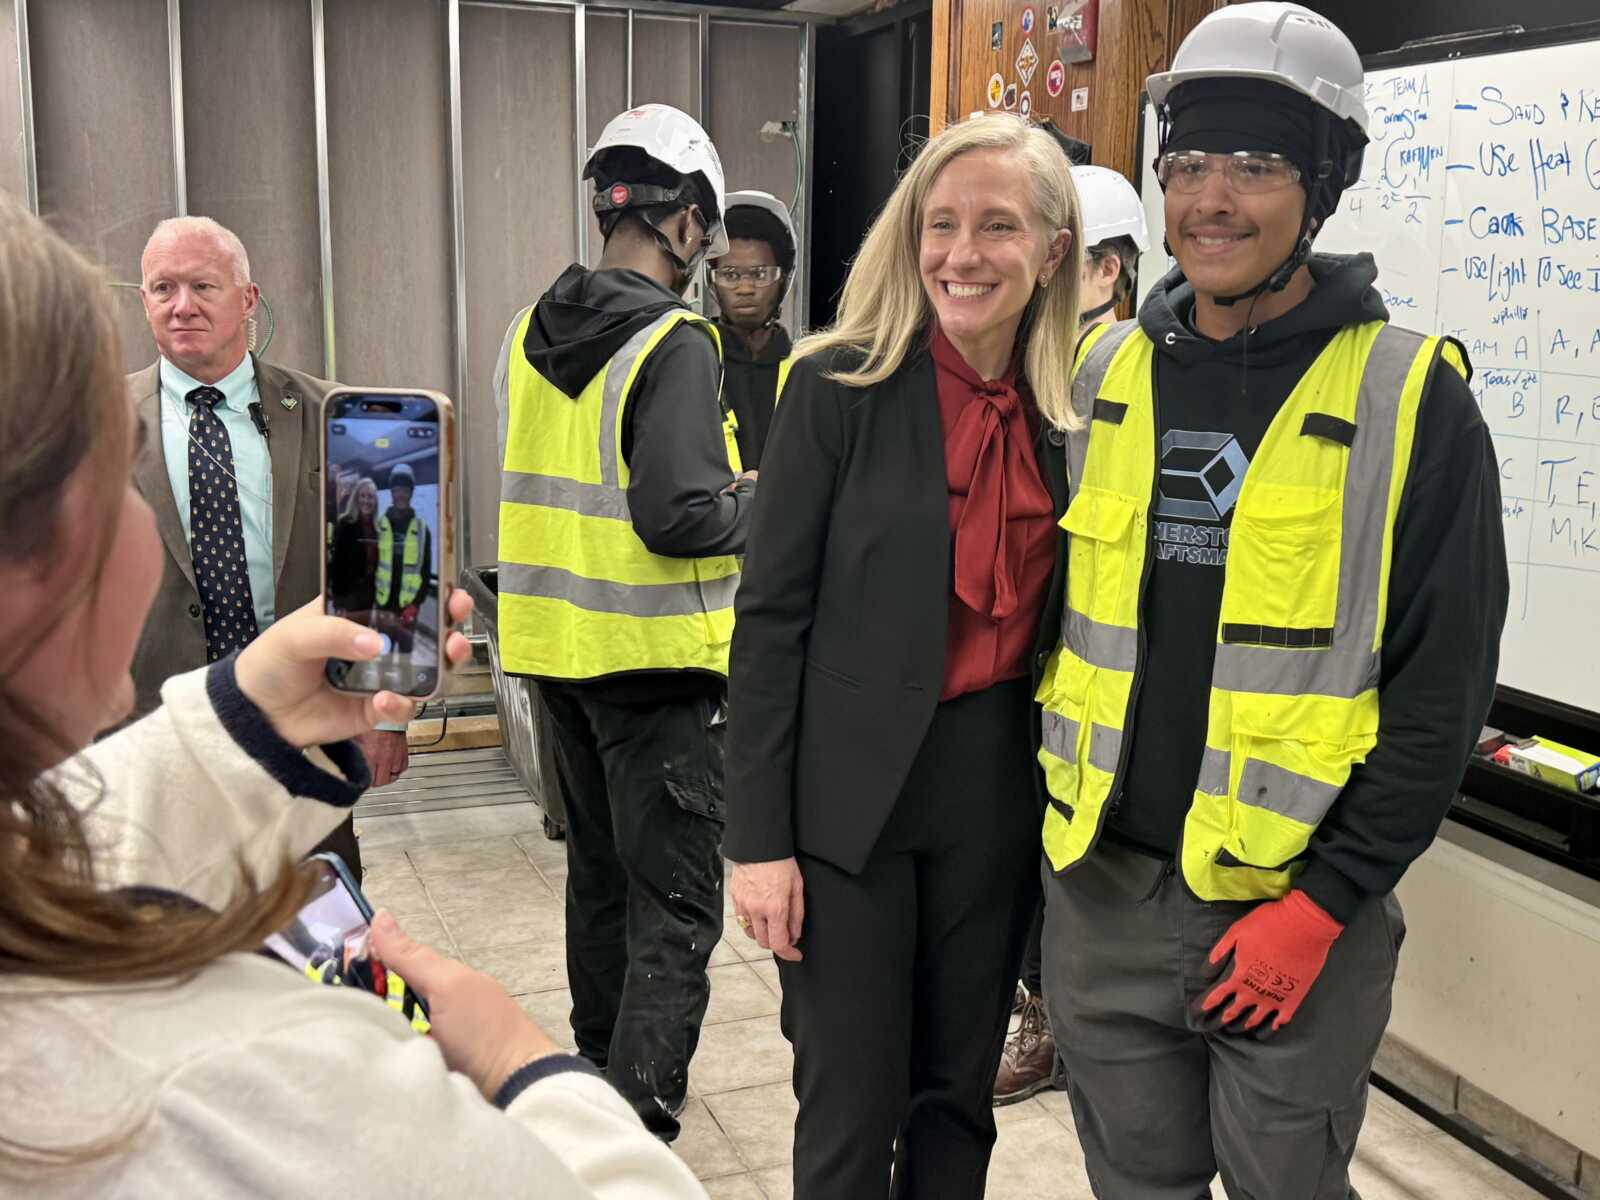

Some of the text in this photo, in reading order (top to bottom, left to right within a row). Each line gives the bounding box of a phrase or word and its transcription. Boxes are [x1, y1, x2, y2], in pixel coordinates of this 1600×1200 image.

[1418, 71, 1430, 106] A
[1480, 86, 1545, 126] SAND
[1514, 335, 1529, 361] A
[1507, 391, 1525, 419] B
